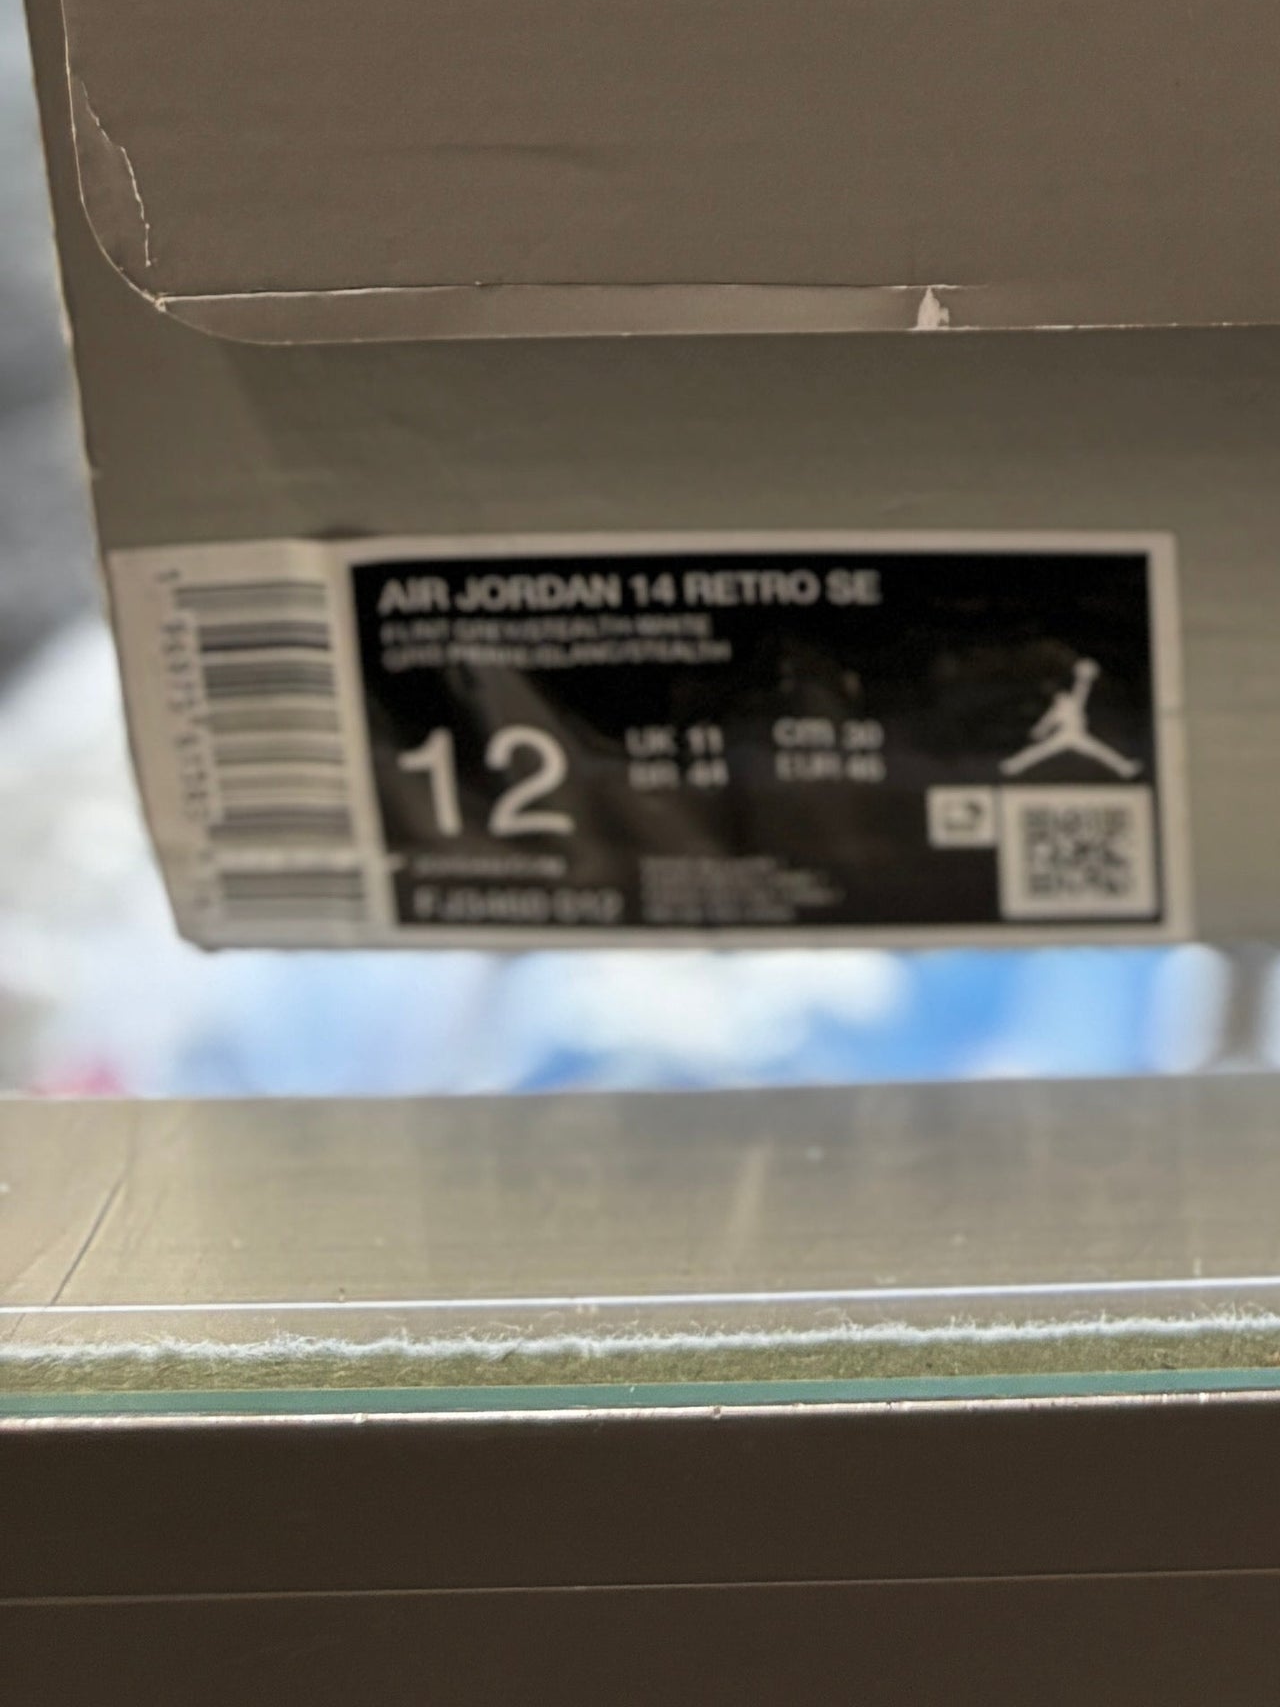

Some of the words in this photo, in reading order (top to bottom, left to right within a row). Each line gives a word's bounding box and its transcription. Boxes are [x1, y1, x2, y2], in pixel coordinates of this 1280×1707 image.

[377, 573, 451, 617] AIR
[453, 571, 622, 613] JORDAN
[628, 571, 678, 608] 14
[681, 567, 821, 607] RETRO
[824, 565, 883, 607] SE
[397, 724, 576, 836] 12
